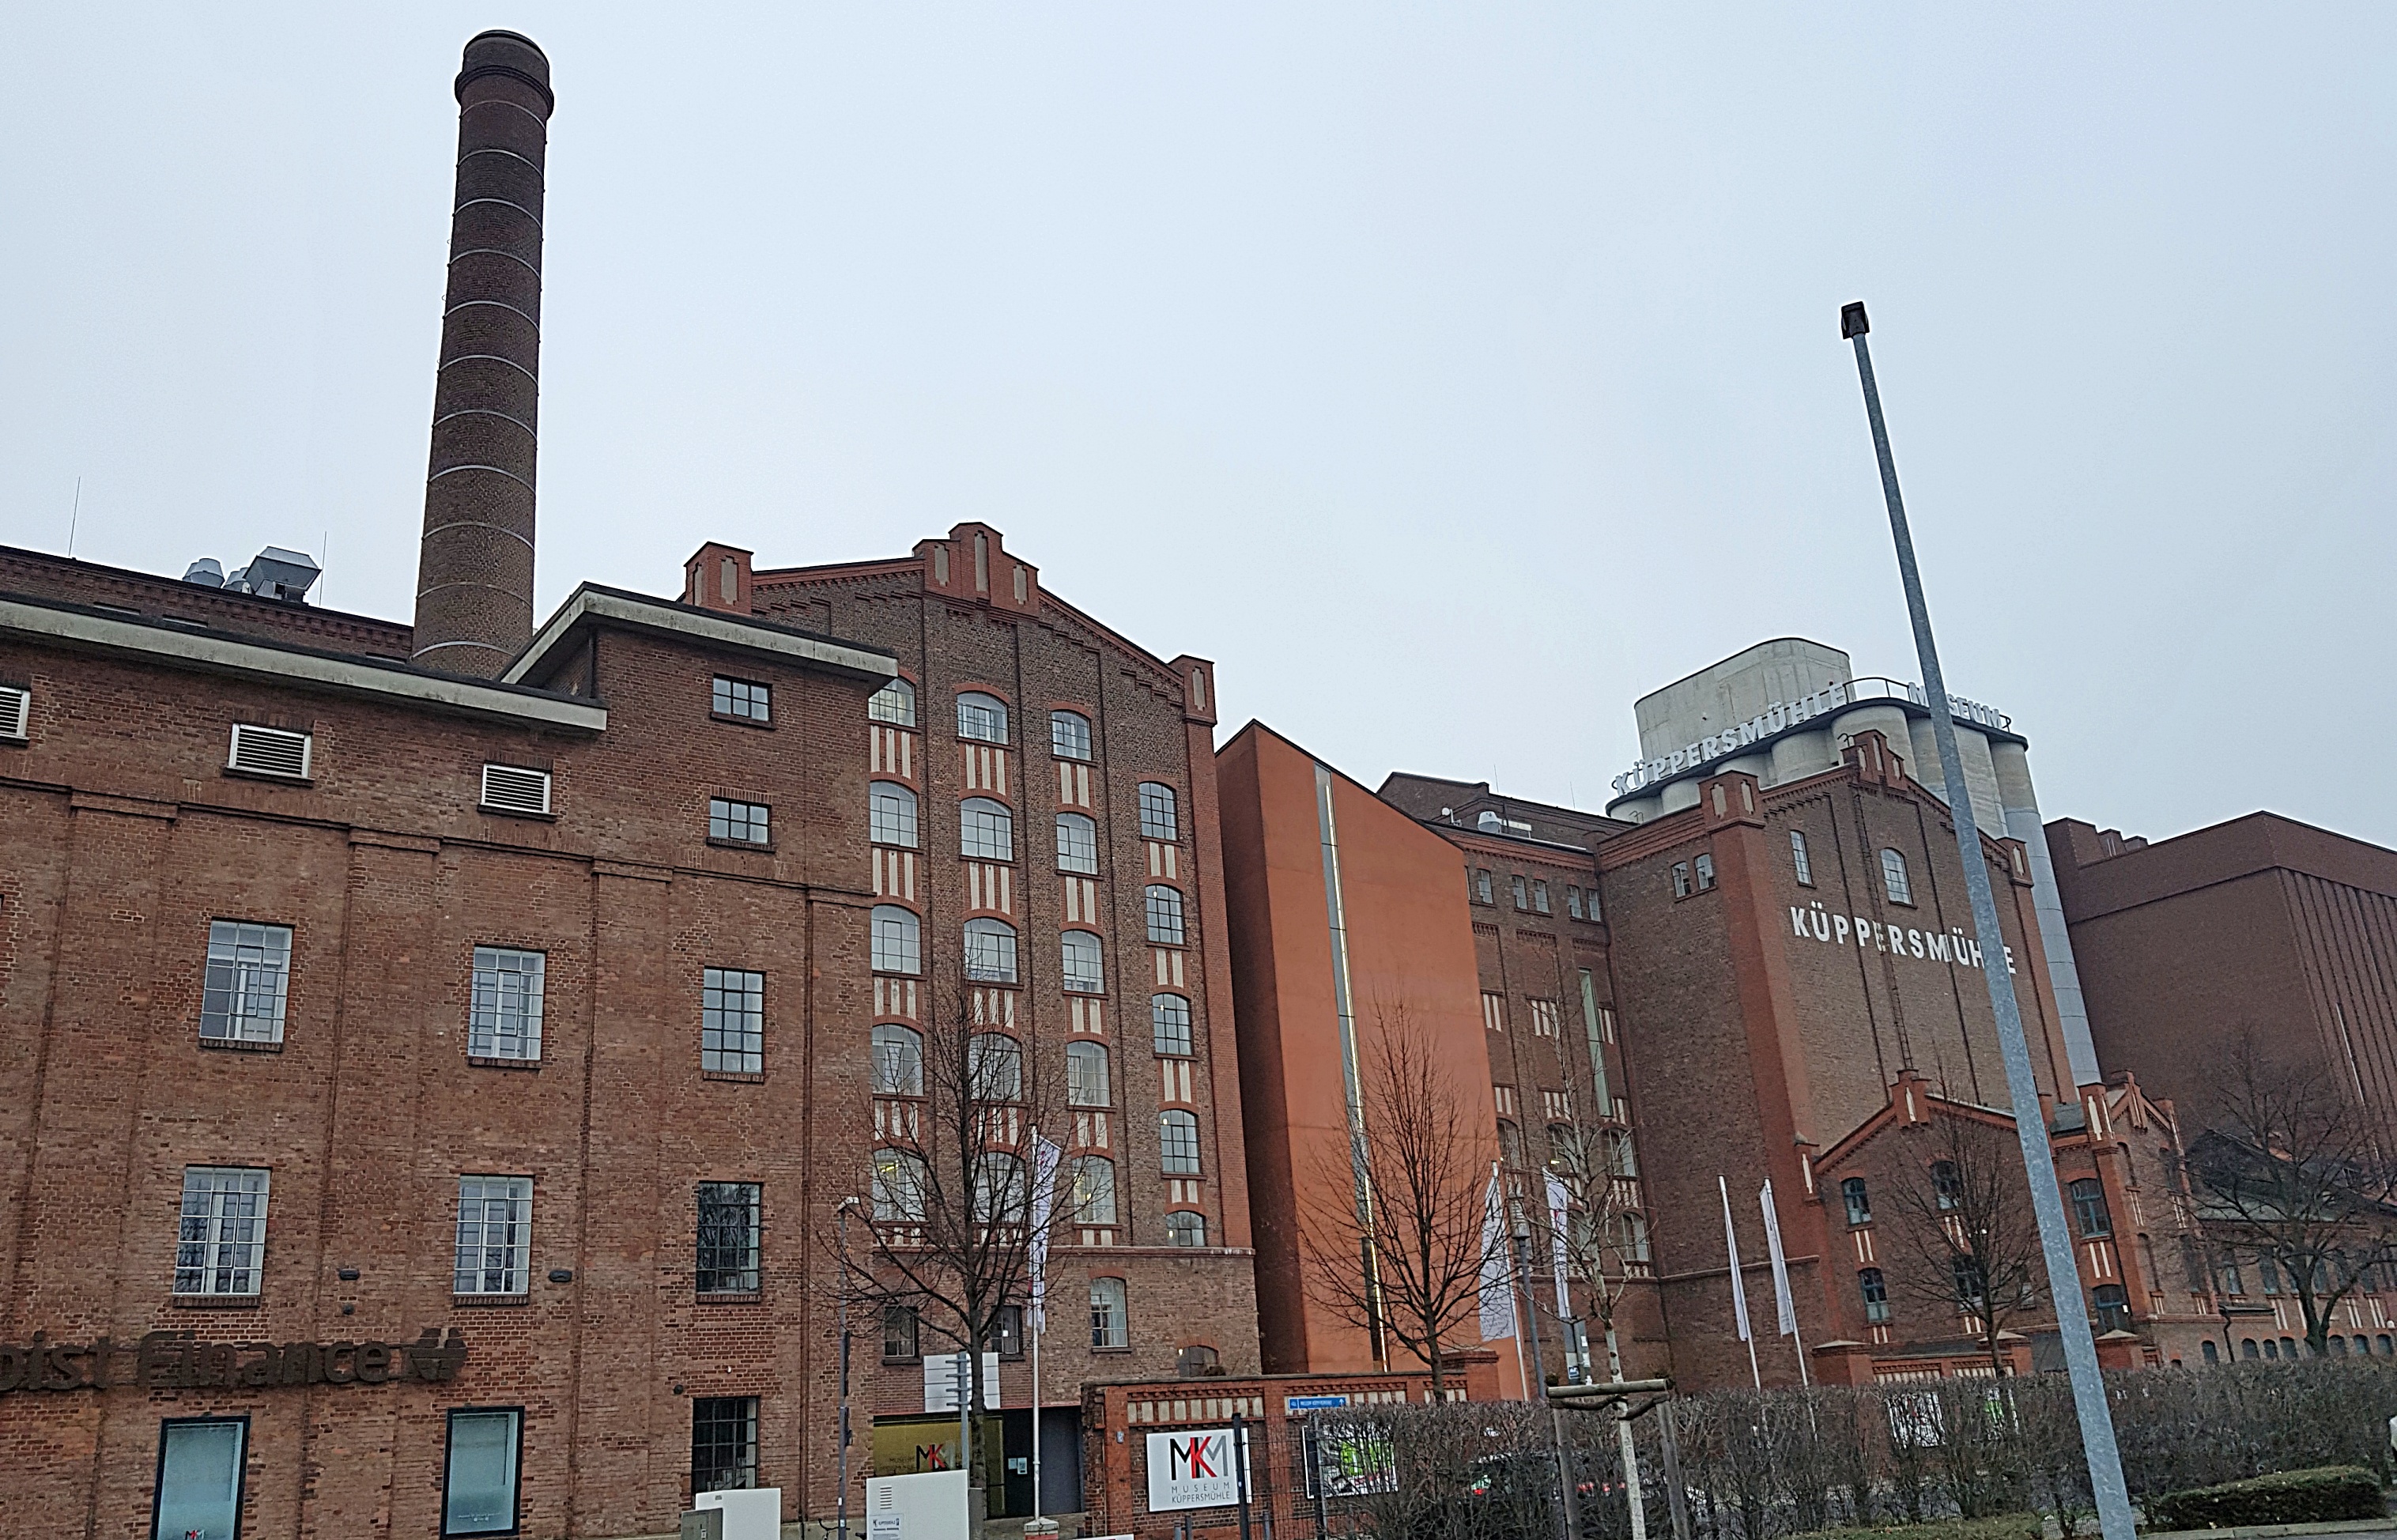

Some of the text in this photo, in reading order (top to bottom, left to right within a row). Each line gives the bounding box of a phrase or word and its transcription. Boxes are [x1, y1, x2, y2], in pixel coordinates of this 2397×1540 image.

[1908, 681, 2002, 728] MSEUM
[1615, 682, 1848, 796] KÜPPERSMÜHLE
[1790, 900, 2016, 974] KÜPPERSMÜHE
[137, 1330, 391, 1385] Finance
[1169, 1435, 1229, 1481] MKM
[1171, 1481, 1229, 1494] MUSEUM
[1172, 1490, 1230, 1504] KÜPPERSMÜHLE
